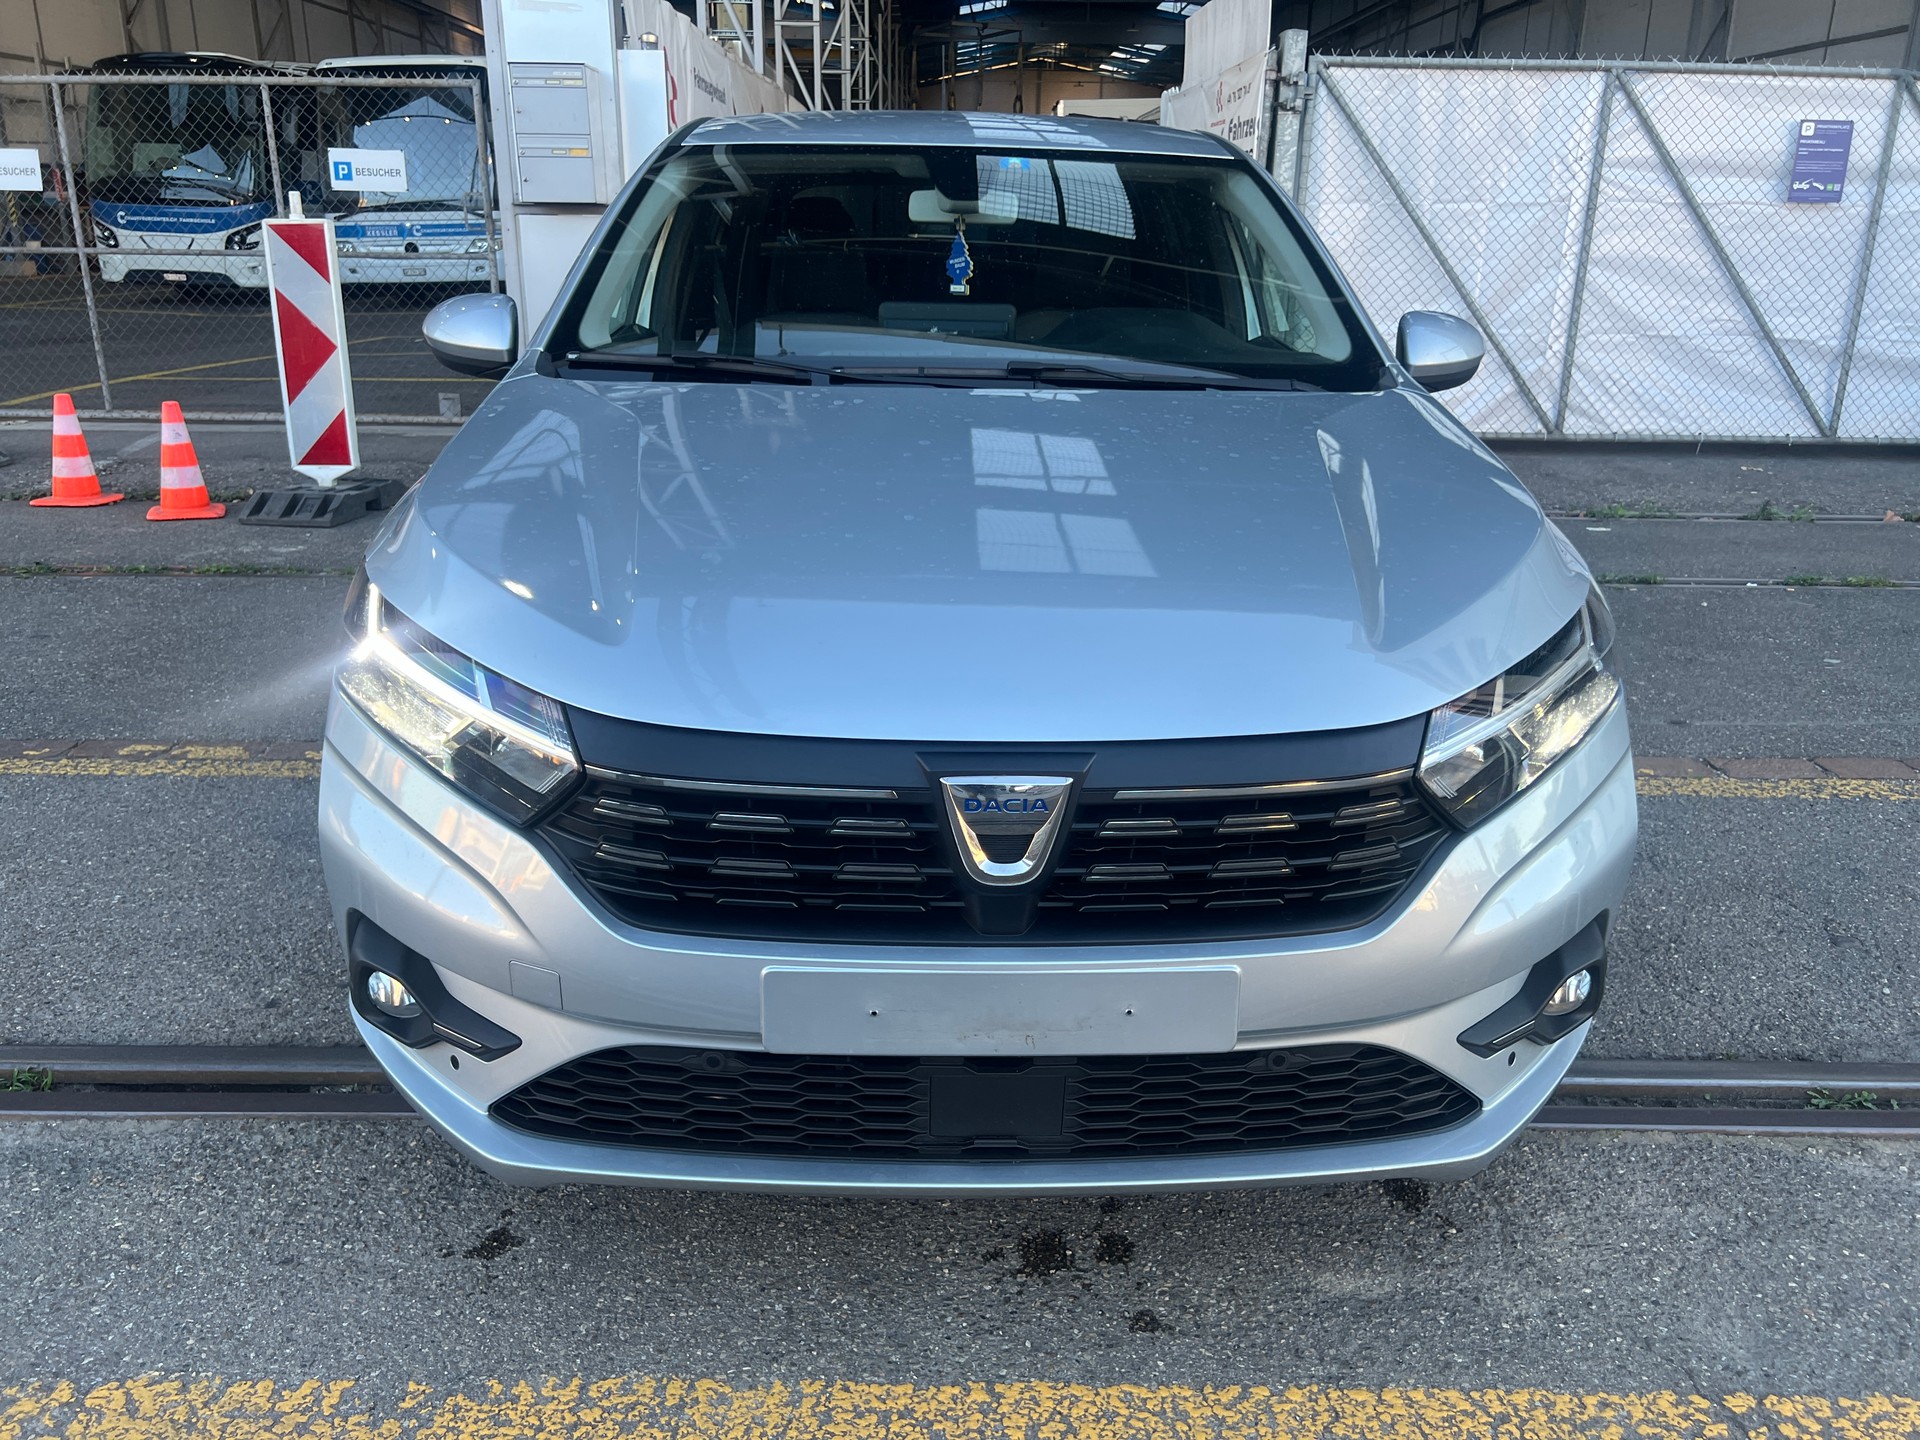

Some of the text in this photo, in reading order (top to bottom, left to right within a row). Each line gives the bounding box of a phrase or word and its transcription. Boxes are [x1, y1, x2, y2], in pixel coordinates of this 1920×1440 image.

[338, 164, 402, 179] P BESUCHER
[963, 798, 1049, 814] DACIA
